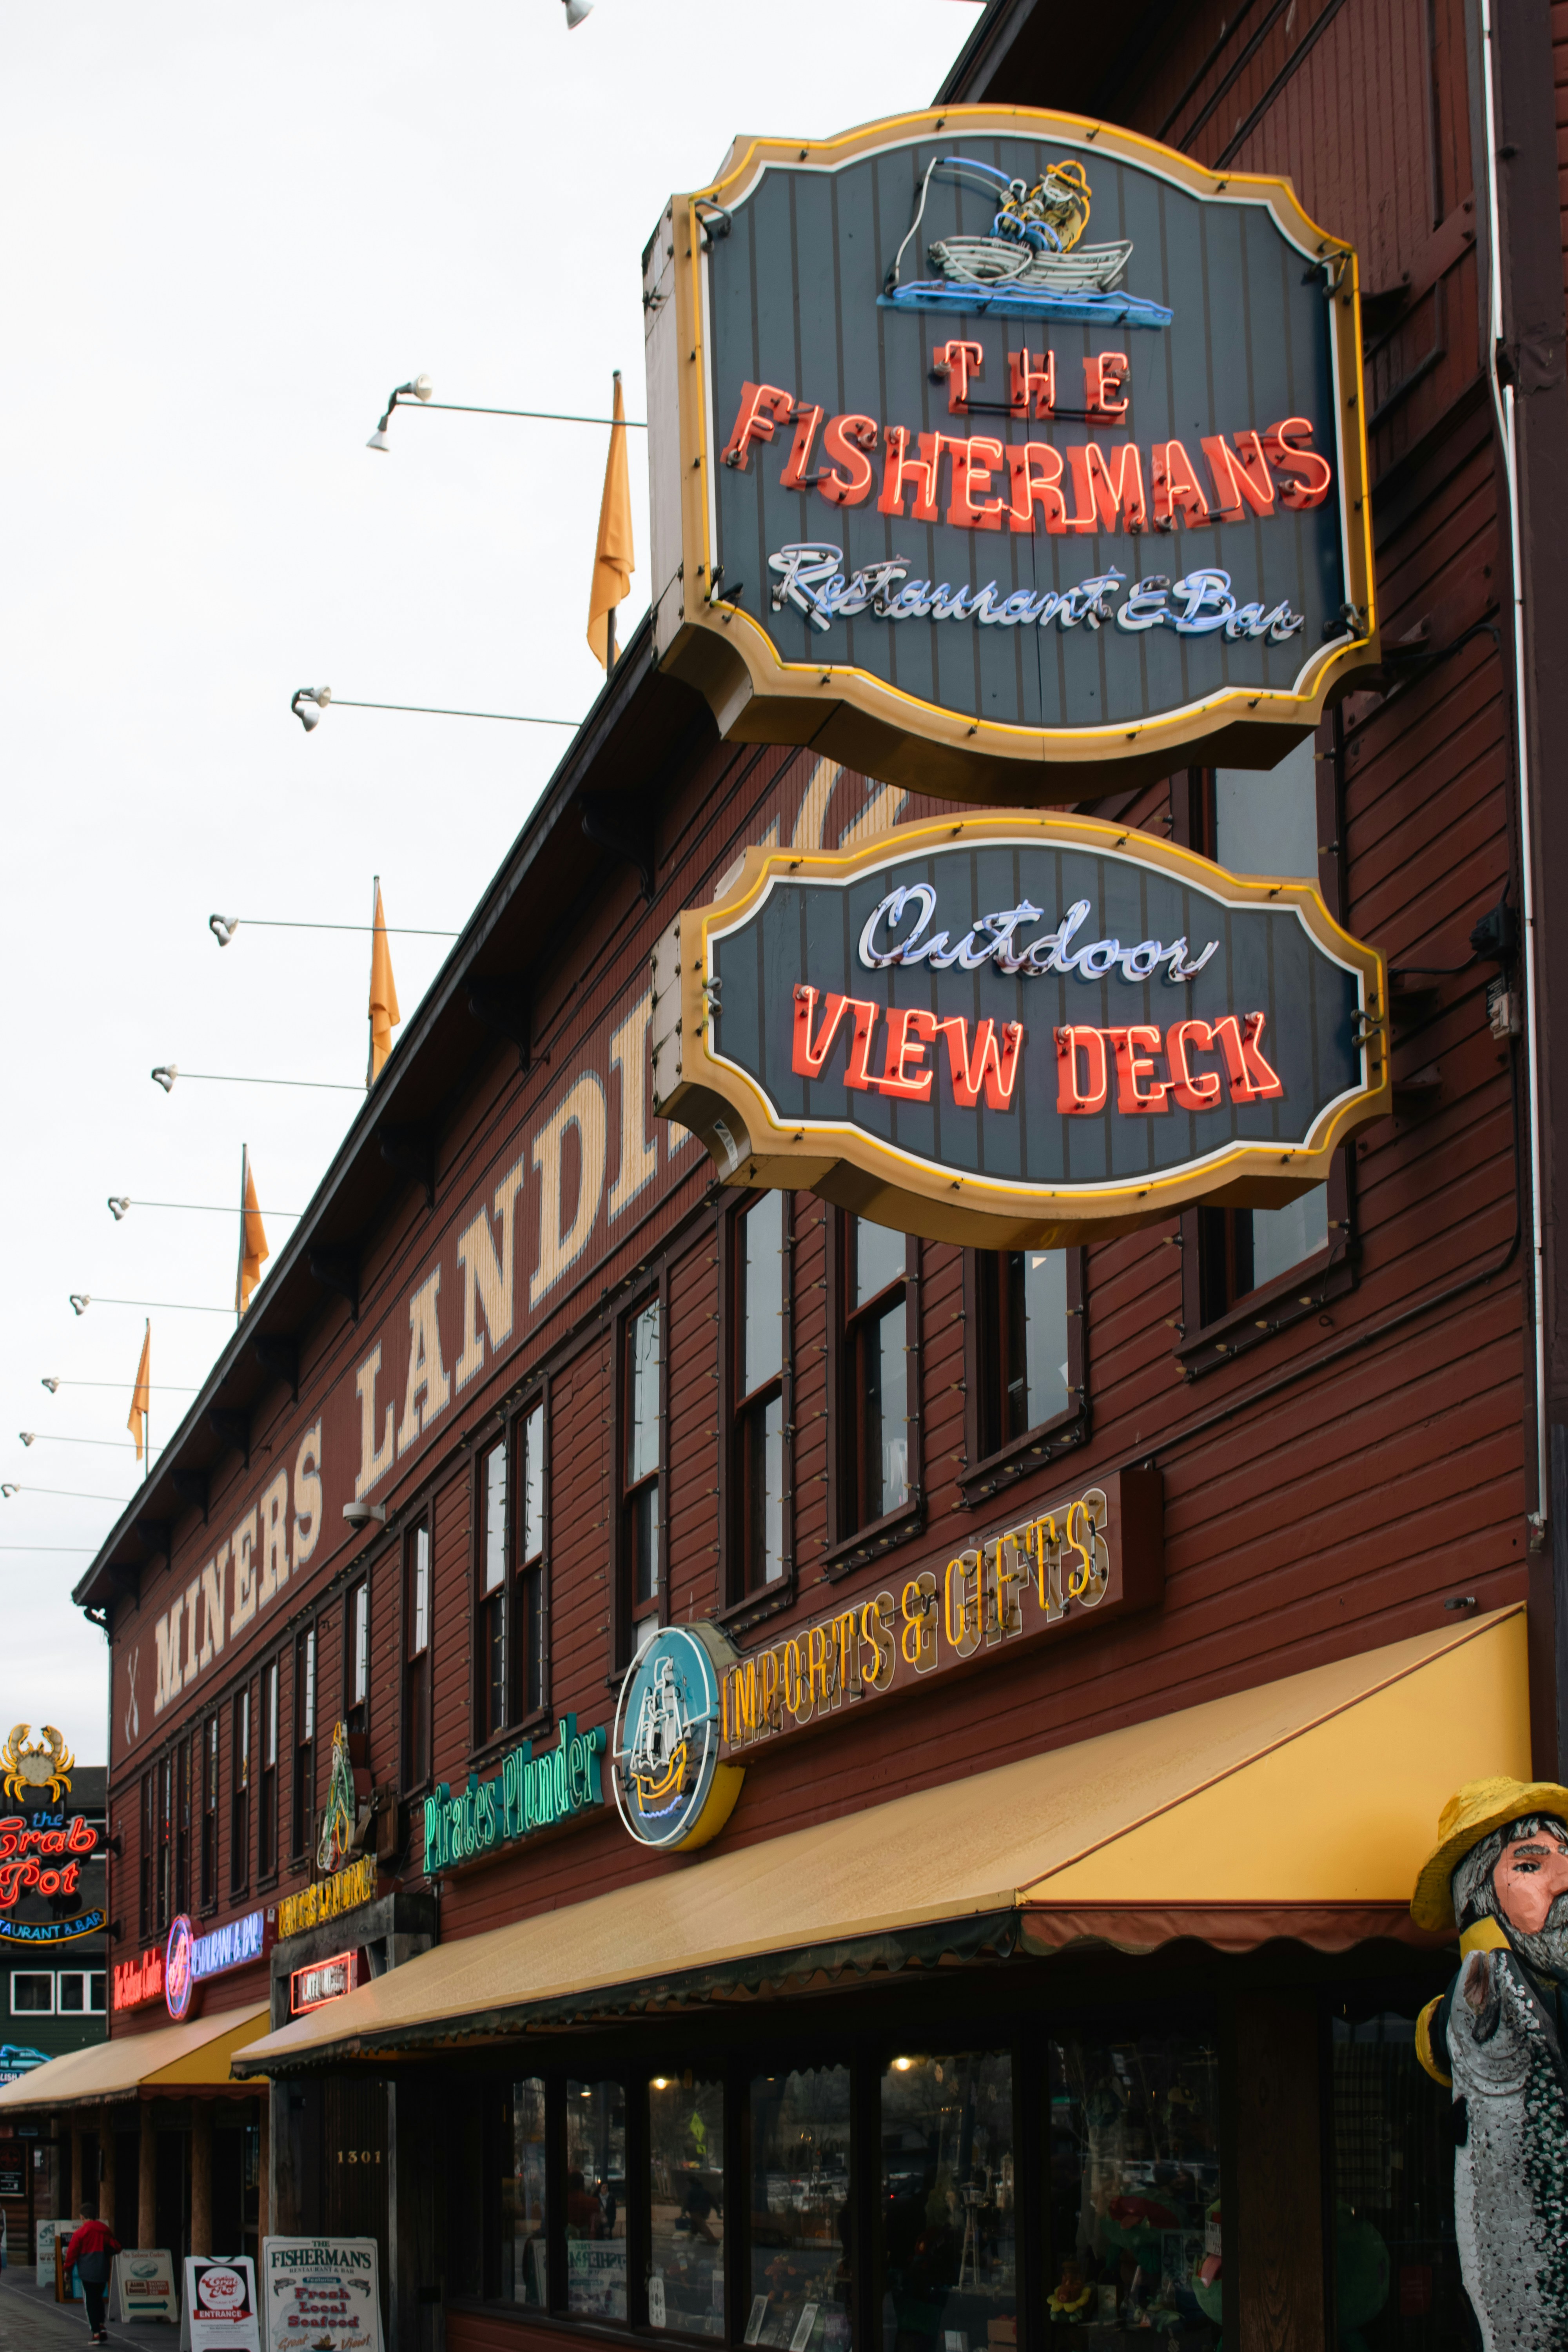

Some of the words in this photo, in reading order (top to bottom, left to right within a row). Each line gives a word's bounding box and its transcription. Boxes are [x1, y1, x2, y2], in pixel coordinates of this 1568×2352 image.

[933, 340, 1131, 425] THE
[720, 379, 1333, 534] FISHERMANS
[767, 543, 1126, 632] Restaurant
[1164, 568, 1305, 641] Bar
[859, 883, 1220, 982] Outdoor
[792, 983, 1023, 1110] VIEW
[1053, 1011, 1283, 1115] DECK
[154, 1418, 323, 1716] MINERS
[723, 1591, 896, 1751] IMPORTS
[902, 1572, 938, 1673] &
[945, 1488, 1109, 1657] GIFTS
[423, 1773, 503, 1874] Pirates
[502, 1713, 606, 1839] Plunder
[33, 1811, 64, 1828] the
[0, 1856, 81, 1909] Pot
[64, 1923, 72, 1936] &
[76, 1912, 103, 1934] BAR
[338, 2151, 380, 2163] 1301
[271, 2248, 372, 2269] FISHERMAN'S
[202, 2277, 241, 2288] Crab
[294, 2287, 351, 2300] Fresh
[287, 2315, 360, 2328] Seafood
[299, 2301, 347, 2314] Local
[278, 2333, 310, 2352] Great
